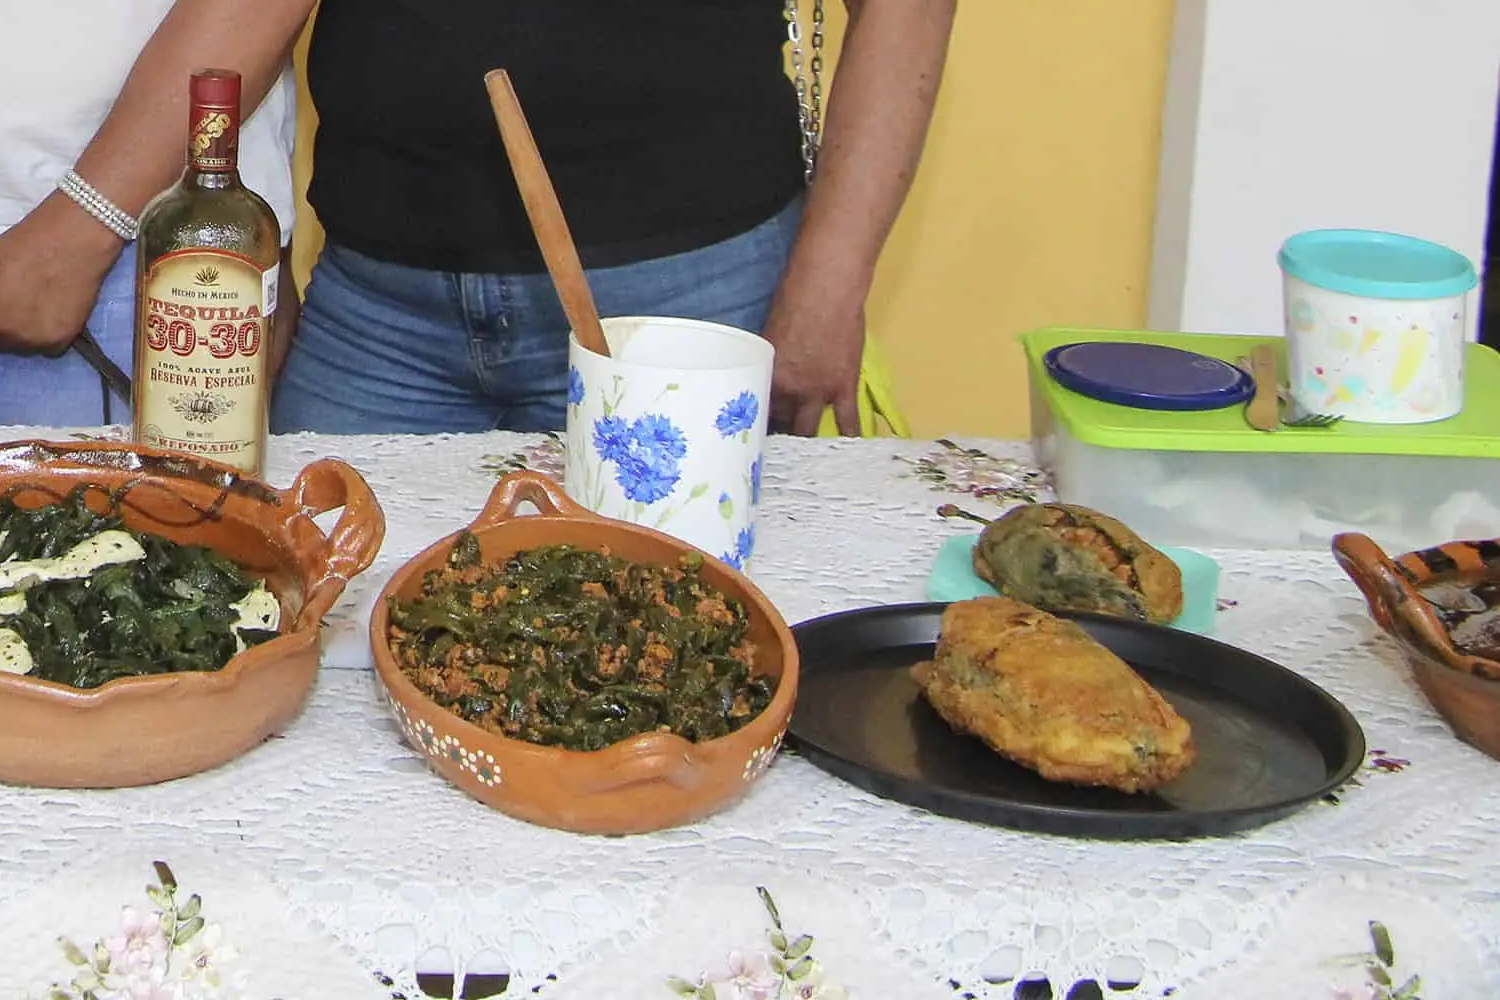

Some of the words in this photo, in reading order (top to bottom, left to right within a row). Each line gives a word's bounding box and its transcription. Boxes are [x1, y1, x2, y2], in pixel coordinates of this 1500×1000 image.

[172, 287, 196, 297] HECHO
[197, 291, 208, 299] EN
[148, 297, 261, 320] TEQUILA
[147, 313, 261, 359] 30-30
[158, 361, 180, 371] 100%
[227, 366, 251, 374] AZUL
[151, 367, 197, 387] RESERVA
[205, 374, 256, 389] ESPECIAL
[158, 437, 239, 452] REPOSADO
